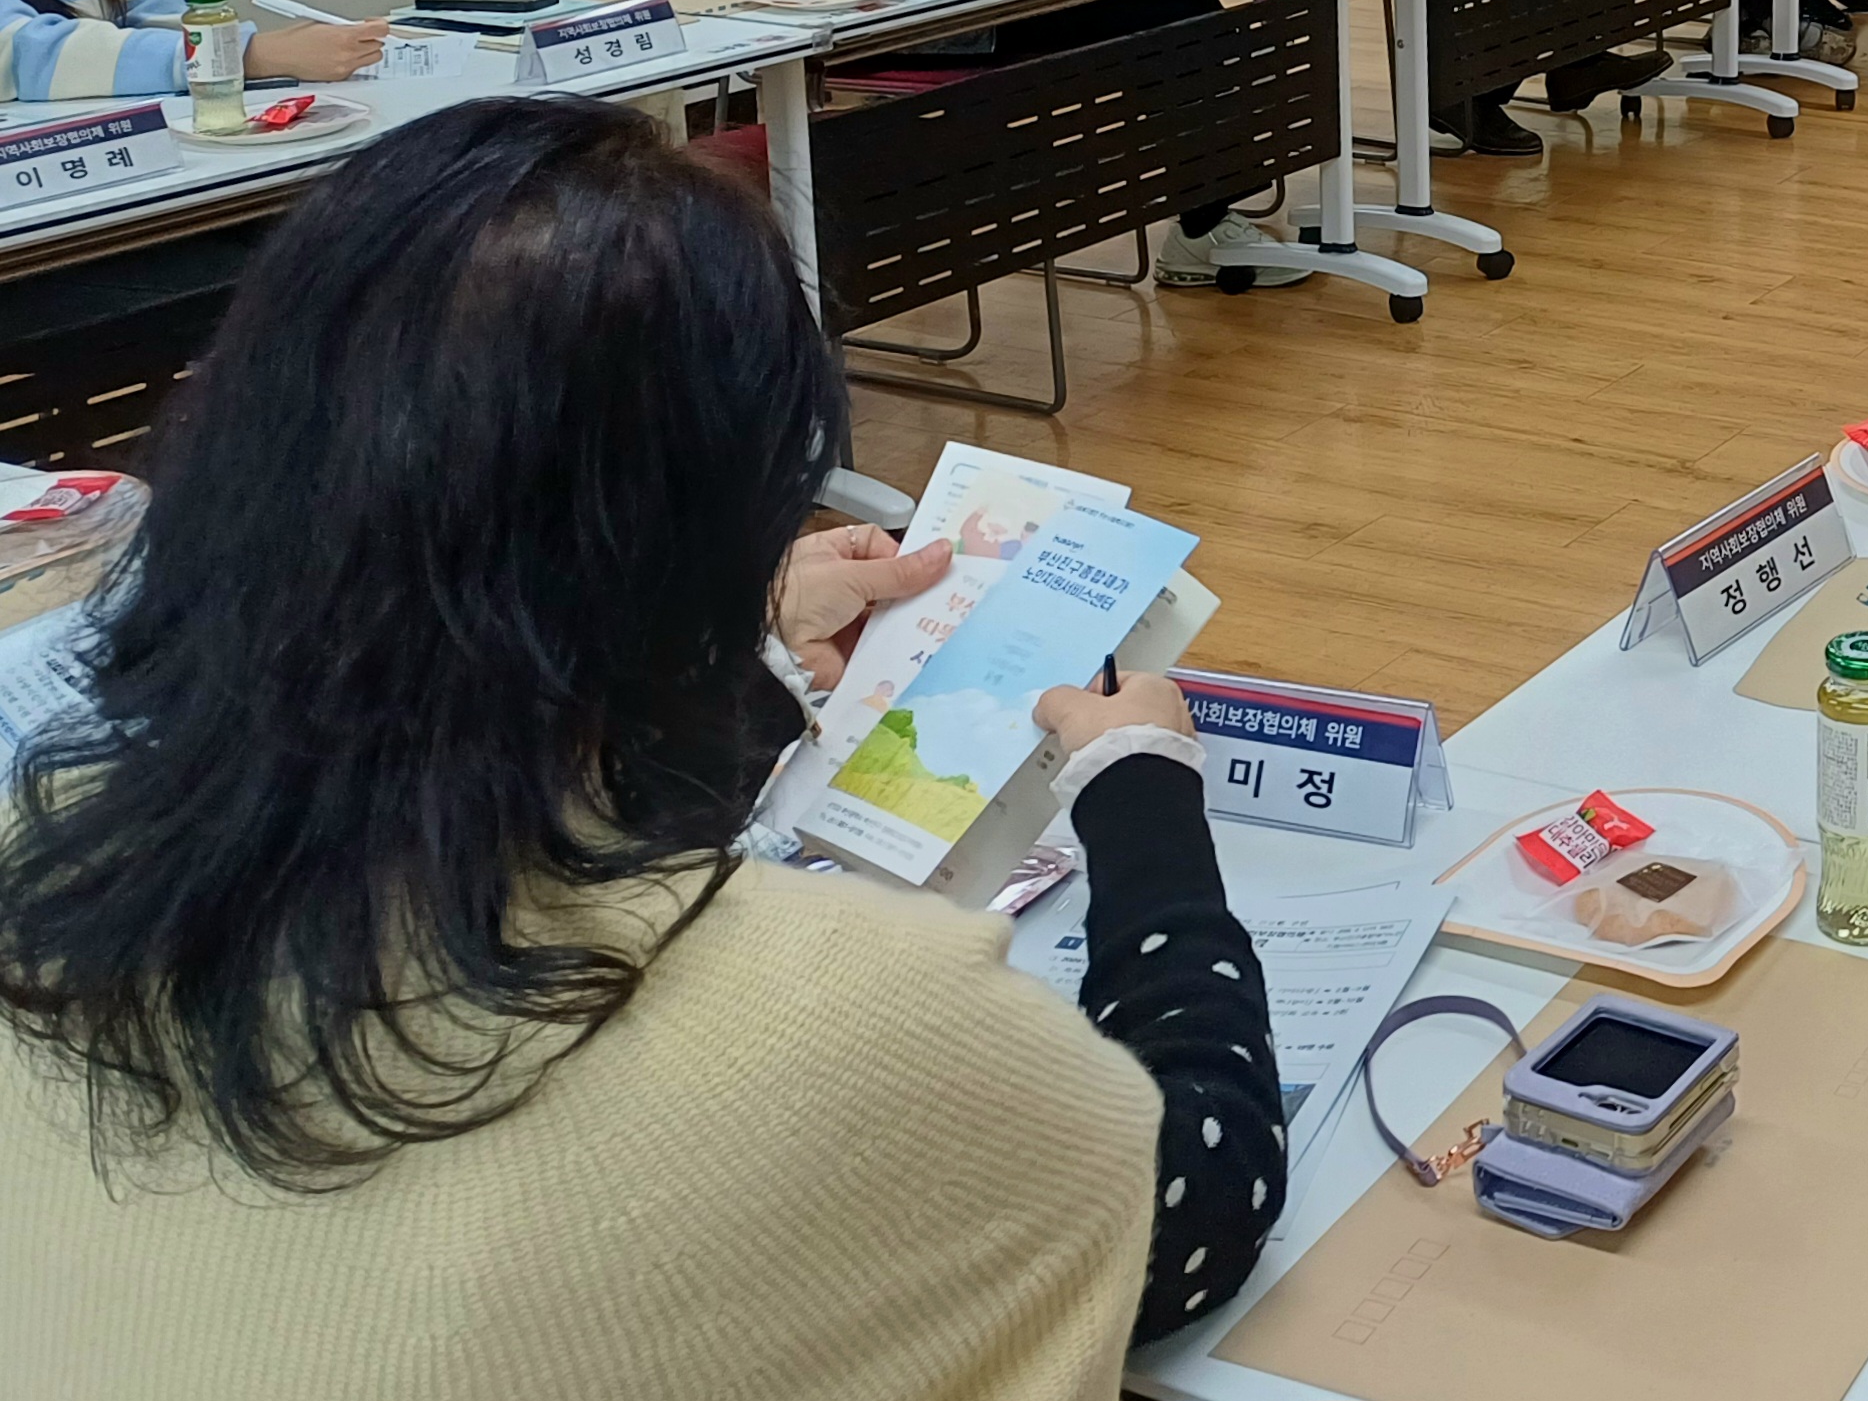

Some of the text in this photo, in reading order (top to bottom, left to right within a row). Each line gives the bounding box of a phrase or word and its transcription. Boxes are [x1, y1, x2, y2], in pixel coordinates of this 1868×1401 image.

[107, 119, 133, 135] 위원
[1699, 493, 1808, 571] 지역사회보장협의체 위원
[1185, 698, 1364, 749] 사회보장협의체 위원
[1296, 768, 1336, 809] 정
